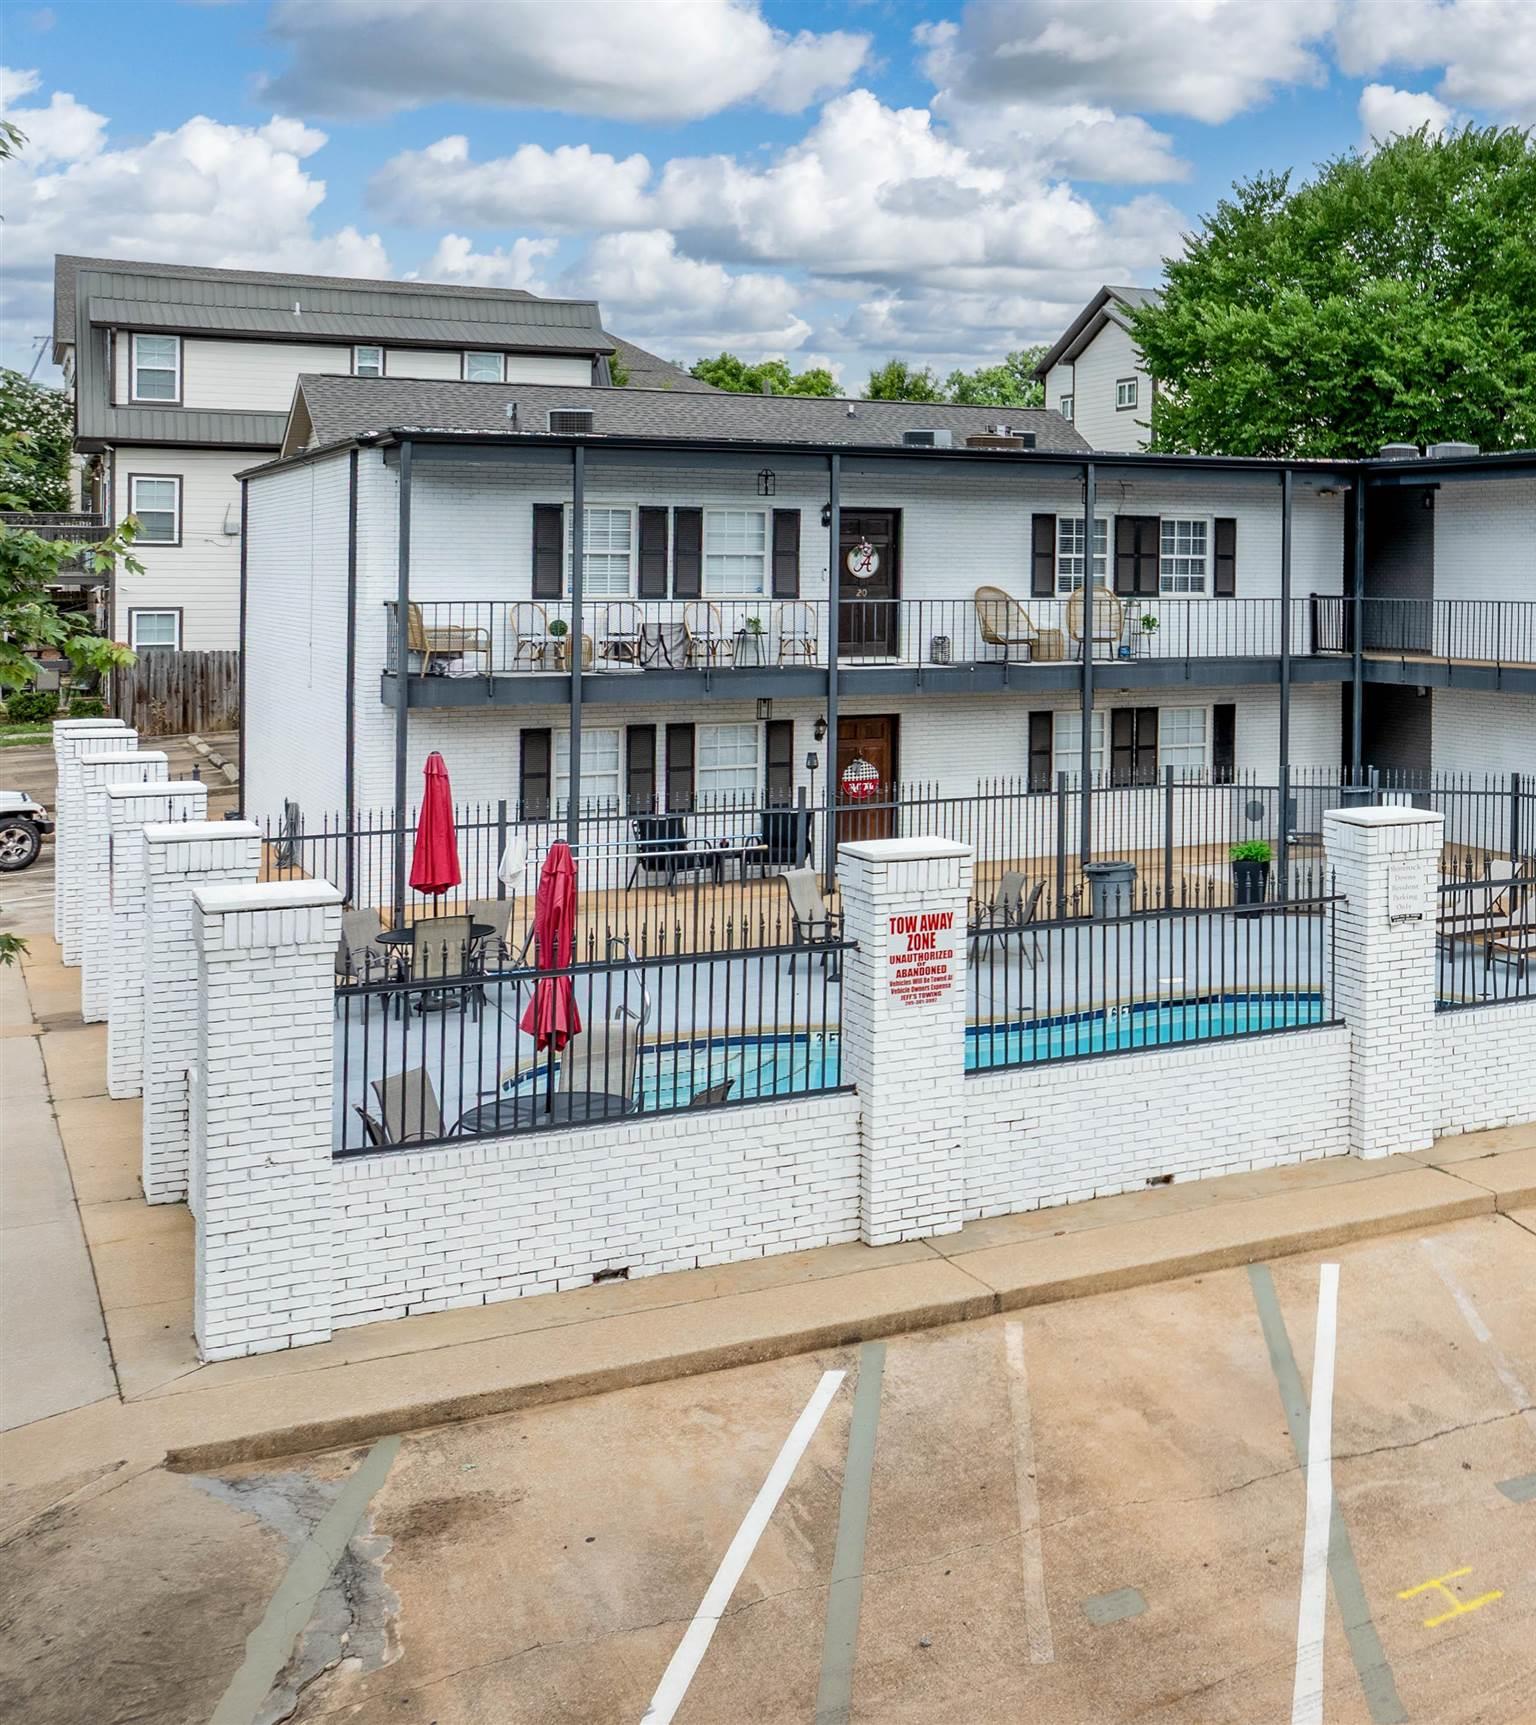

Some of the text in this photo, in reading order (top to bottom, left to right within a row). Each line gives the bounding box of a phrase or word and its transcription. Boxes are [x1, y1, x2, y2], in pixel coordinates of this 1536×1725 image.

[889, 912, 954, 935] TOW AWAY
[907, 932, 936, 951] ZONE
[889, 950, 953, 965] UNAUTHORIZED
[896, 965, 947, 978] ABANDONED
